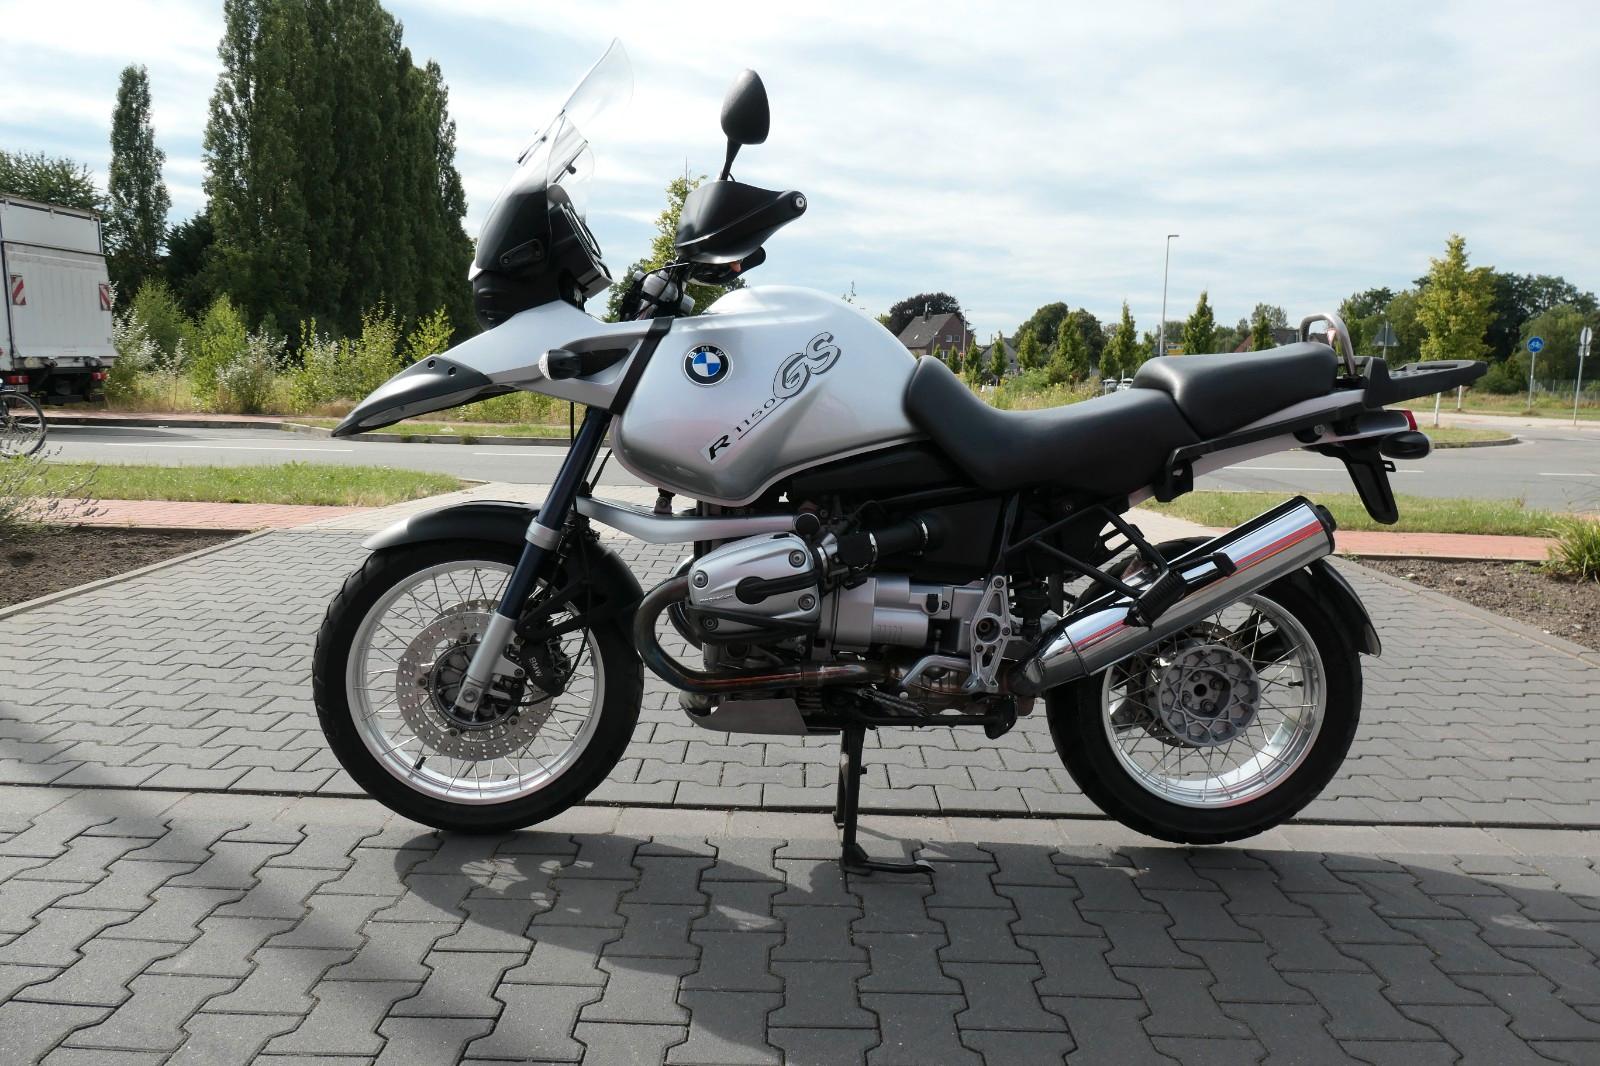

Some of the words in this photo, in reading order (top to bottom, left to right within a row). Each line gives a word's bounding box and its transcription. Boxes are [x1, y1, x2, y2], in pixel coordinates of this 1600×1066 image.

[688, 346, 724, 358] BMW
[708, 434, 732, 461] R
[735, 398, 776, 433] 1150
[772, 331, 842, 400] GS
[529, 656, 544, 677] BMW
